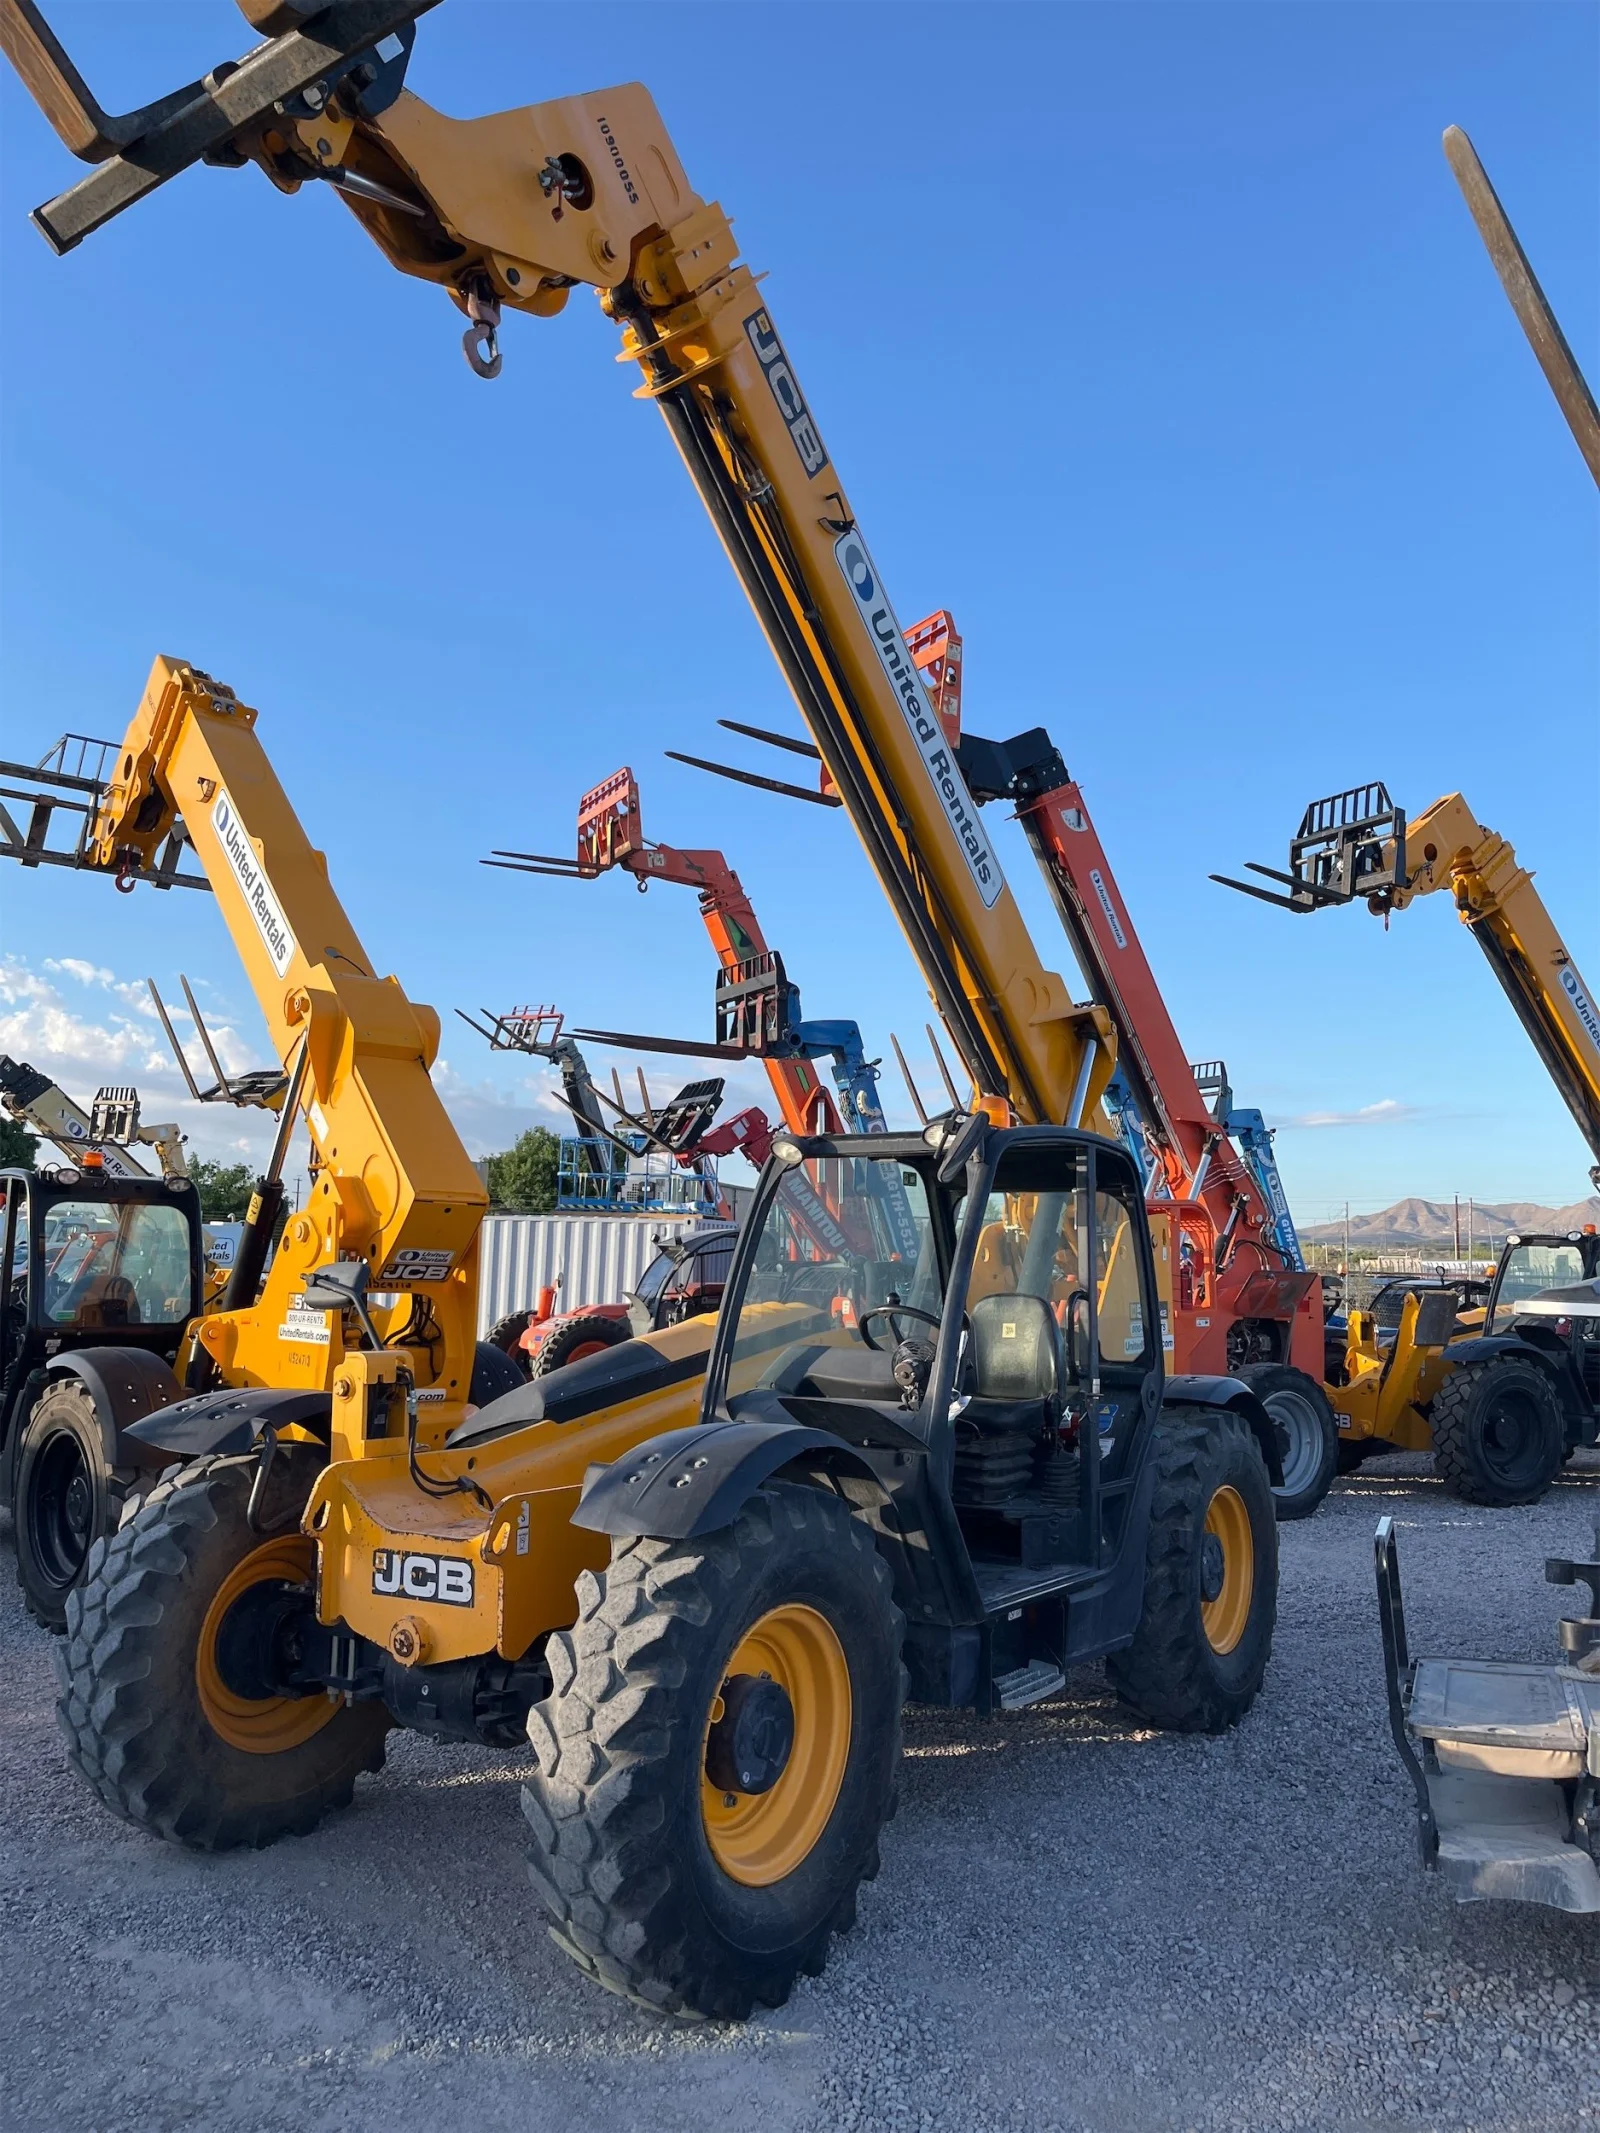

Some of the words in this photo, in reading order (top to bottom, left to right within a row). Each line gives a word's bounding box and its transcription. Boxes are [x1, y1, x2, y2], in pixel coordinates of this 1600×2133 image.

[748, 319, 824, 473] JCB
[871, 609, 937, 744] United
[930, 749, 990, 885] Rentals
[226, 822, 256, 890] United
[251, 882, 286, 960] Rentals
[1097, 885, 1111, 912] United
[1108, 913, 1123, 943] Rentals
[787, 1177, 846, 1248] MANITOU
[887, 1178, 917, 1259] GTH-5519
[383, 1265, 448, 1279] JCB
[279, 1327, 329, 1342] UnitedRentals.com
[374, 1553, 473, 1603] JCB
